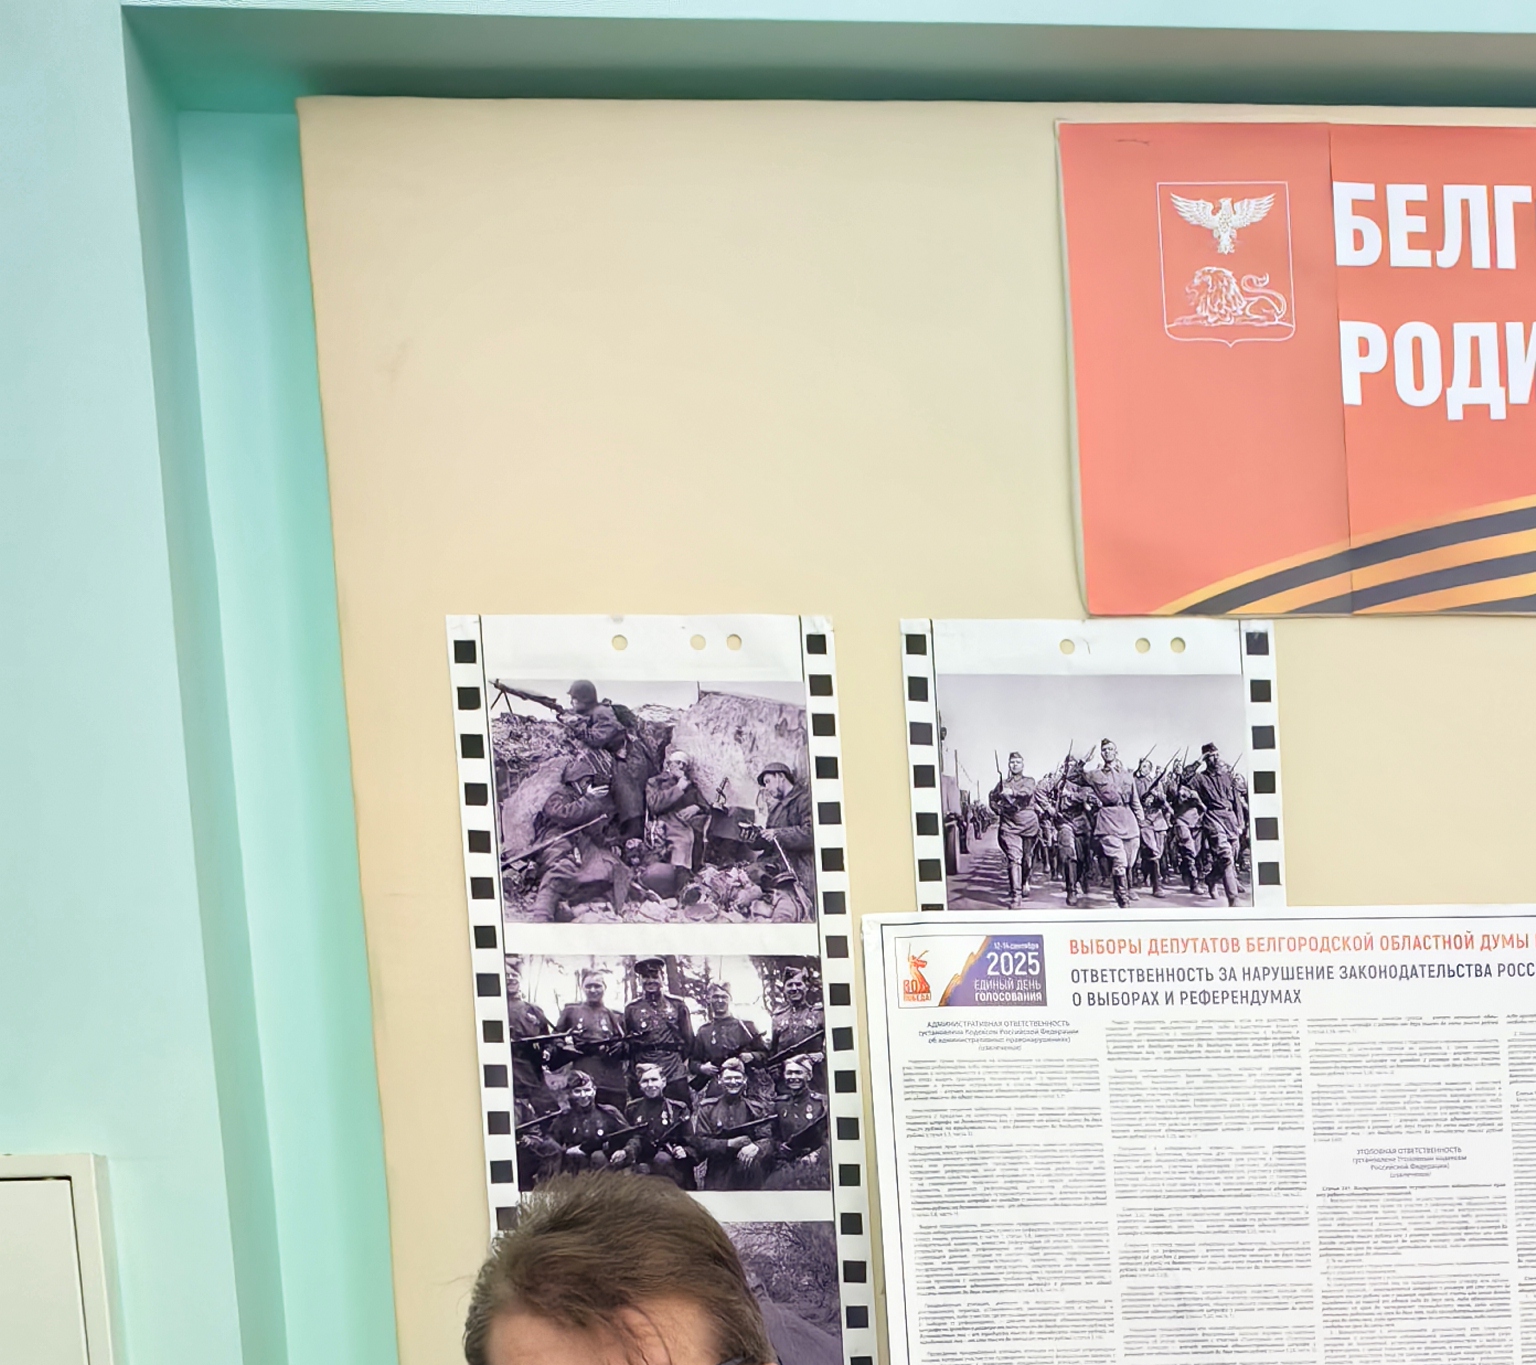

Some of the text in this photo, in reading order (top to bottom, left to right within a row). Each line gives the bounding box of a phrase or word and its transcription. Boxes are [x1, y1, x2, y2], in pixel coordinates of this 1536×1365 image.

[1070, 939, 1141, 954] ВЫБОРЫ
[1148, 938, 1240, 956] ДЕПУТАТОВ
[1246, 933, 1373, 953] БЕЛГОРОДСКОЙ
[1380, 932, 1474, 950] ОБЛАСТНОЙ
[1480, 934, 1528, 951] ДУМЫ
[987, 952, 1040, 976] 2025
[1071, 968, 1214, 983] ОТВЕТСТВЕННОСТЬ
[1219, 967, 1237, 981] ЗА
[1243, 966, 1334, 981] НАРУШЕНИЕ
[1340, 964, 1492, 980] ЗАКОНОДАТЕЛЬСТВА
[975, 977, 1041, 990] ЕДИНЫЙ ДЕНЬ
[1073, 990, 1301, 1006] О ВЫБОРАХ И РЕФЕРЕНДУМАХ
